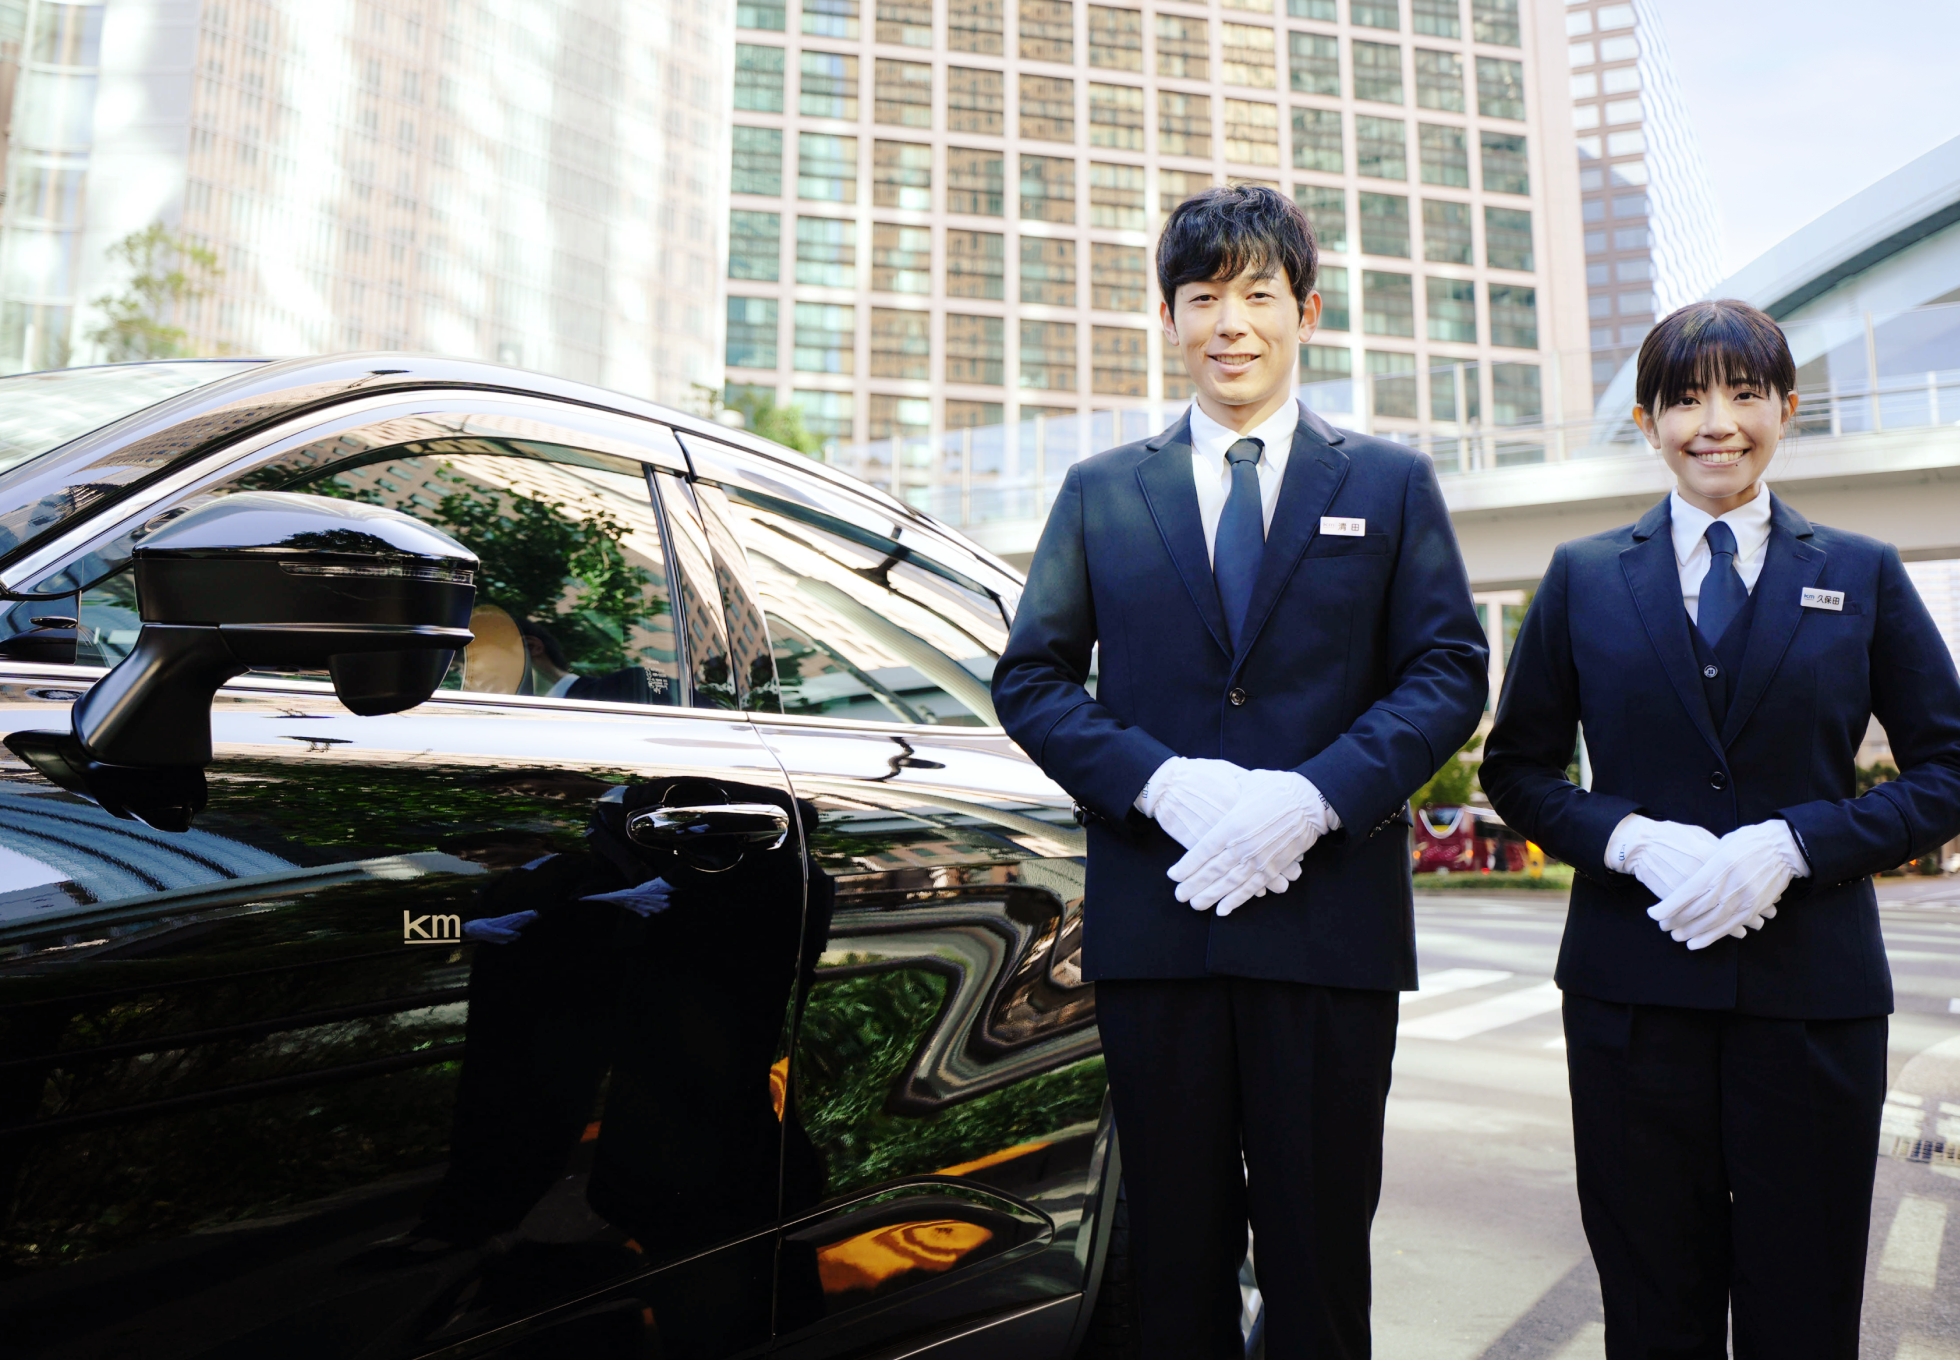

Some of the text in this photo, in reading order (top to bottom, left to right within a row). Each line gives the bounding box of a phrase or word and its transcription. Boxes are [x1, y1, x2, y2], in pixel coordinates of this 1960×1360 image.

[1816, 594, 1840, 606] 久保田
[403, 909, 461, 940] km
